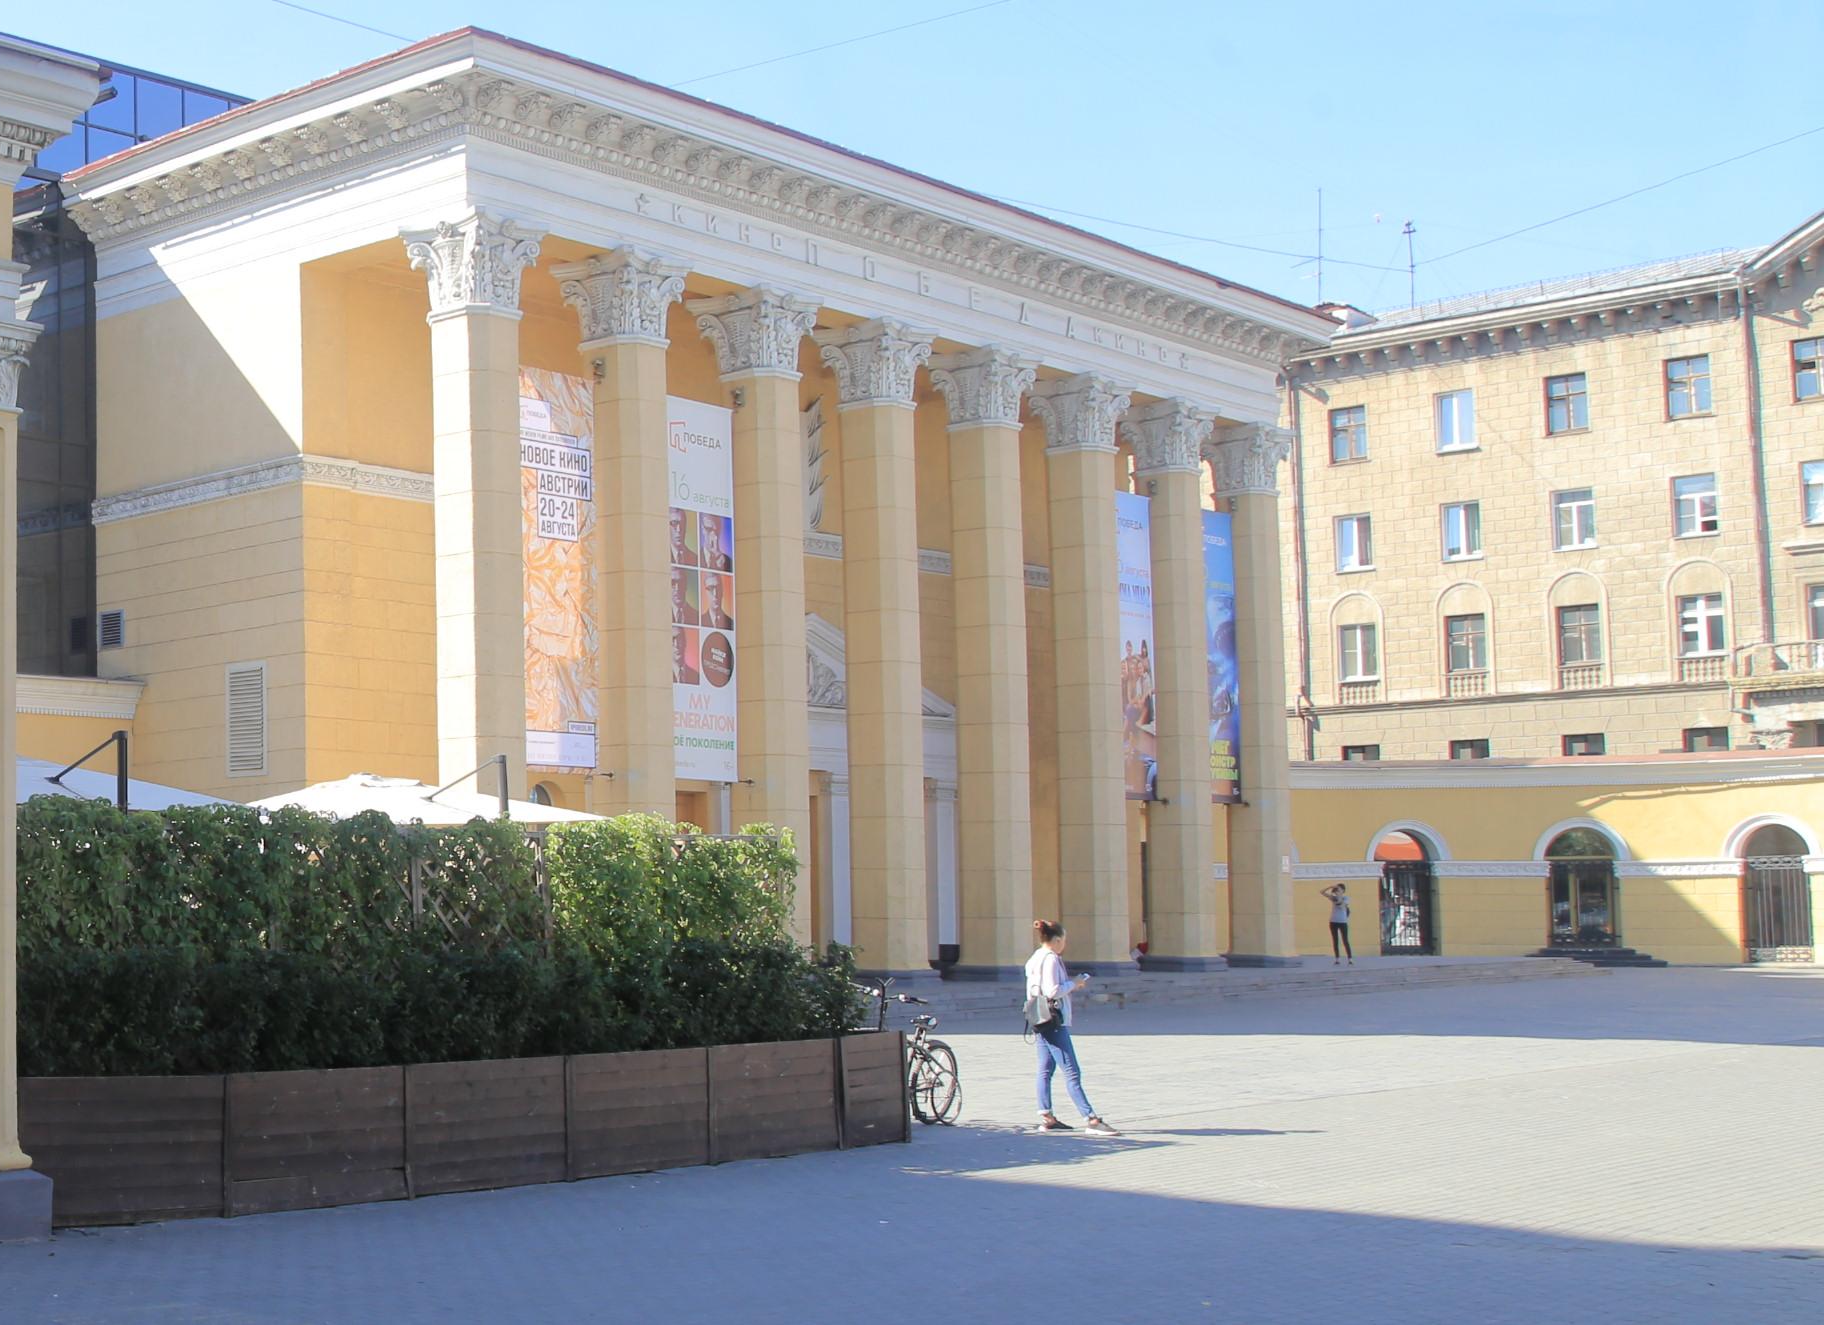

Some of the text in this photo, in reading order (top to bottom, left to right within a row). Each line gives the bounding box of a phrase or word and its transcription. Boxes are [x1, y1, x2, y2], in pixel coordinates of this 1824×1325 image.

[684, 432, 722, 450] ПОБЕДА
[520, 444, 588, 473] НОВОЕ КИНО
[540, 473, 588, 498] АВСТРИИ
[672, 471, 729, 509] 16 августа
[540, 498, 575, 521] 20-24
[541, 520, 576, 537] АВГУСТА
[689, 692, 710, 710] MY
[672, 711, 735, 732] ENERATION
[686, 736, 735, 750] ПОКОЛЕНИЕ
[1210, 755, 1236, 768] ОНСТР
